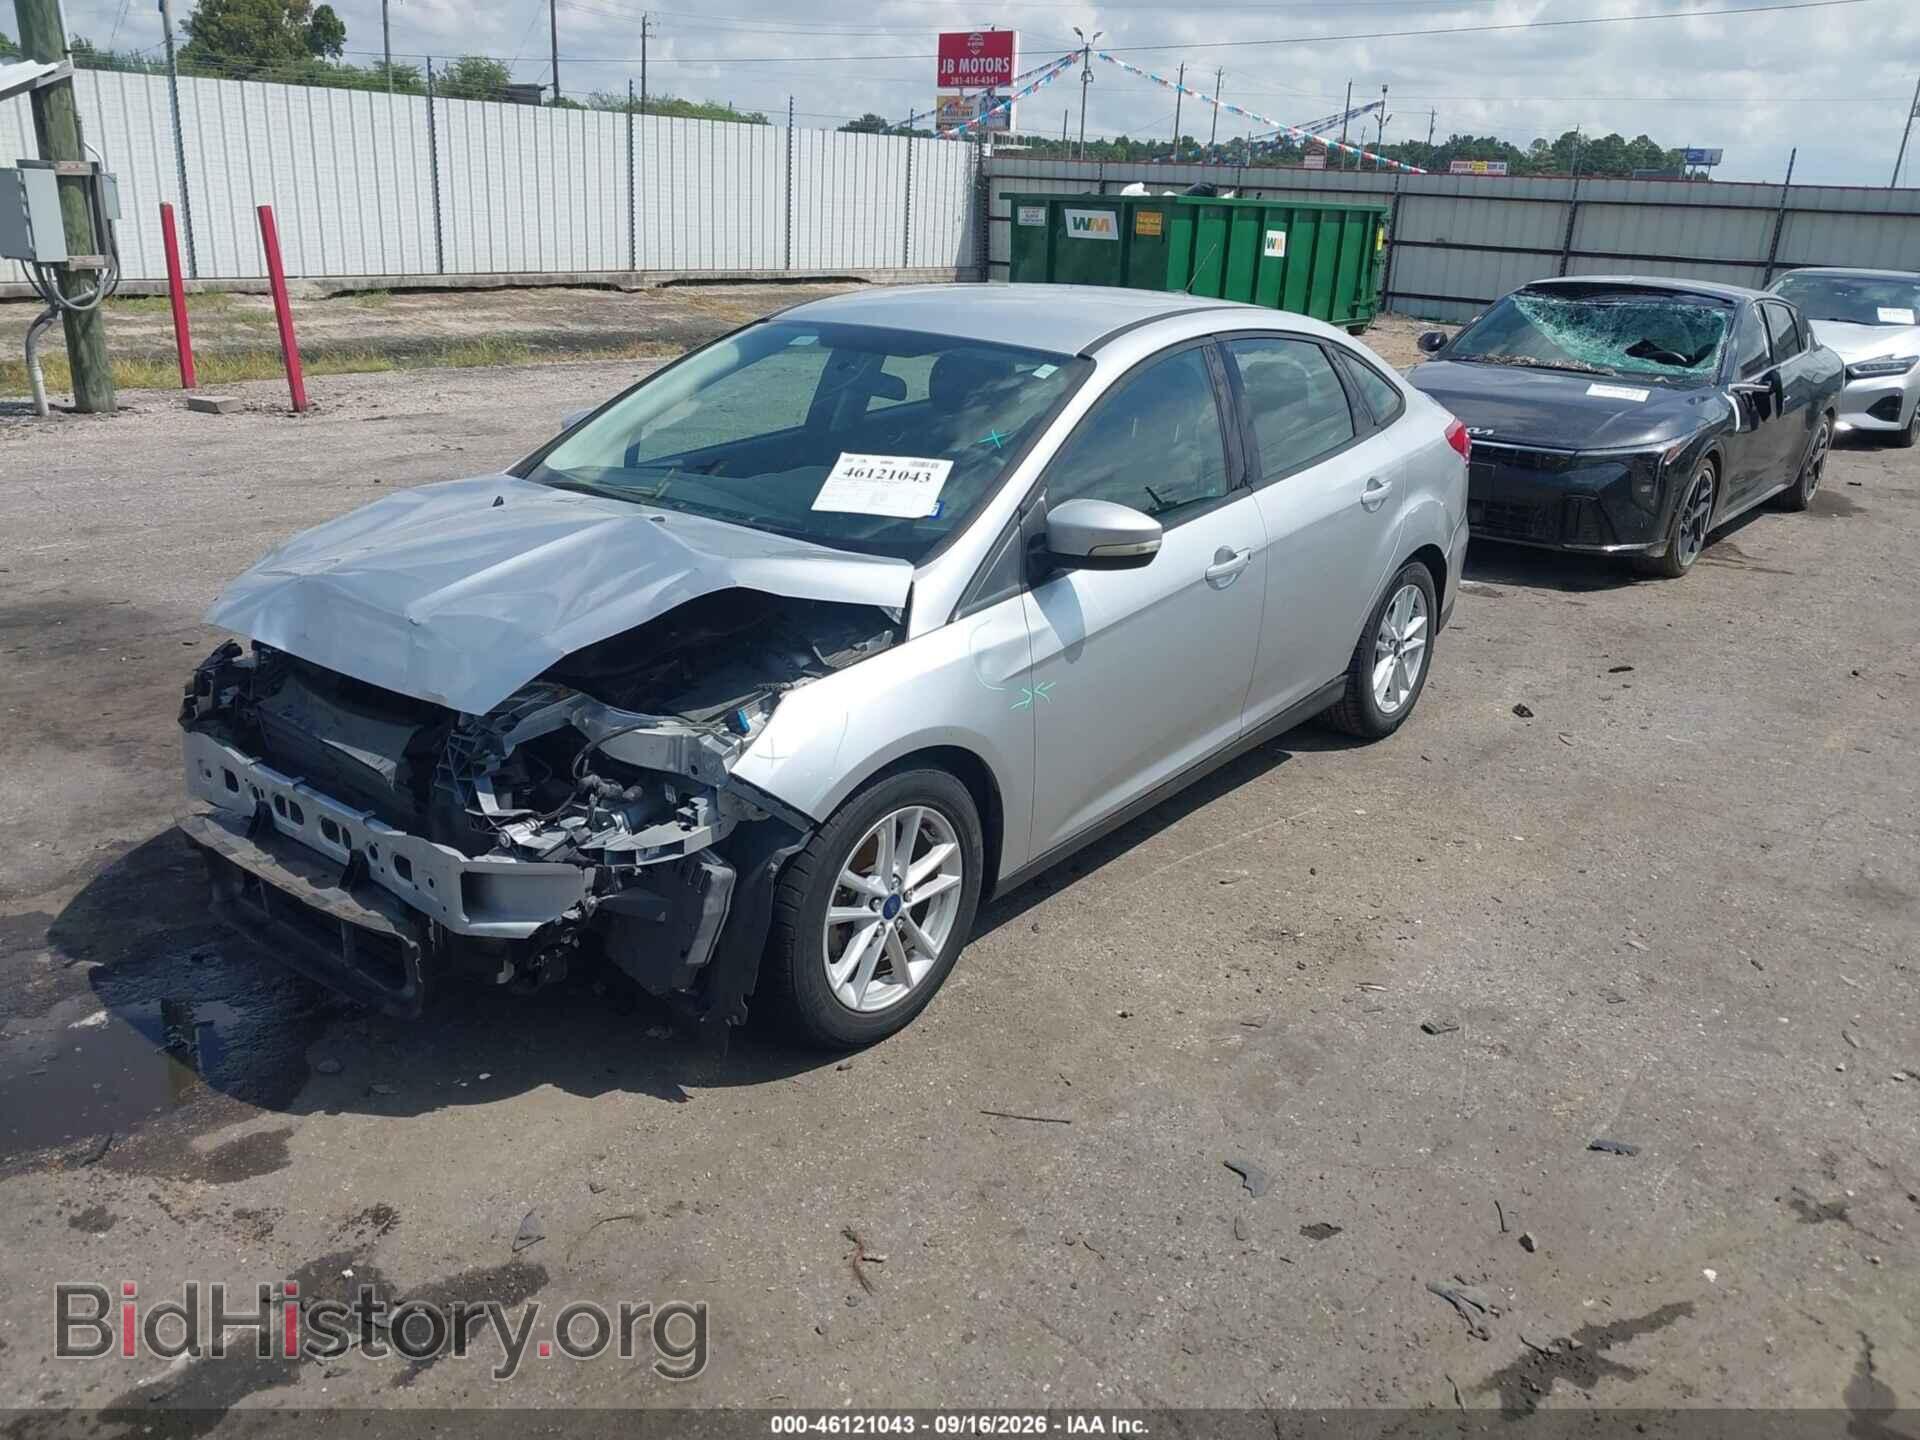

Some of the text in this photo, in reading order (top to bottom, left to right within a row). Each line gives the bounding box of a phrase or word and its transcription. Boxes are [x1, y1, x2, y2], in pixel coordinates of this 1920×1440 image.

[941, 57, 1009, 74] JB MOTORS
[1073, 216, 1111, 232] WM
[843, 467, 932, 483] 46121043
